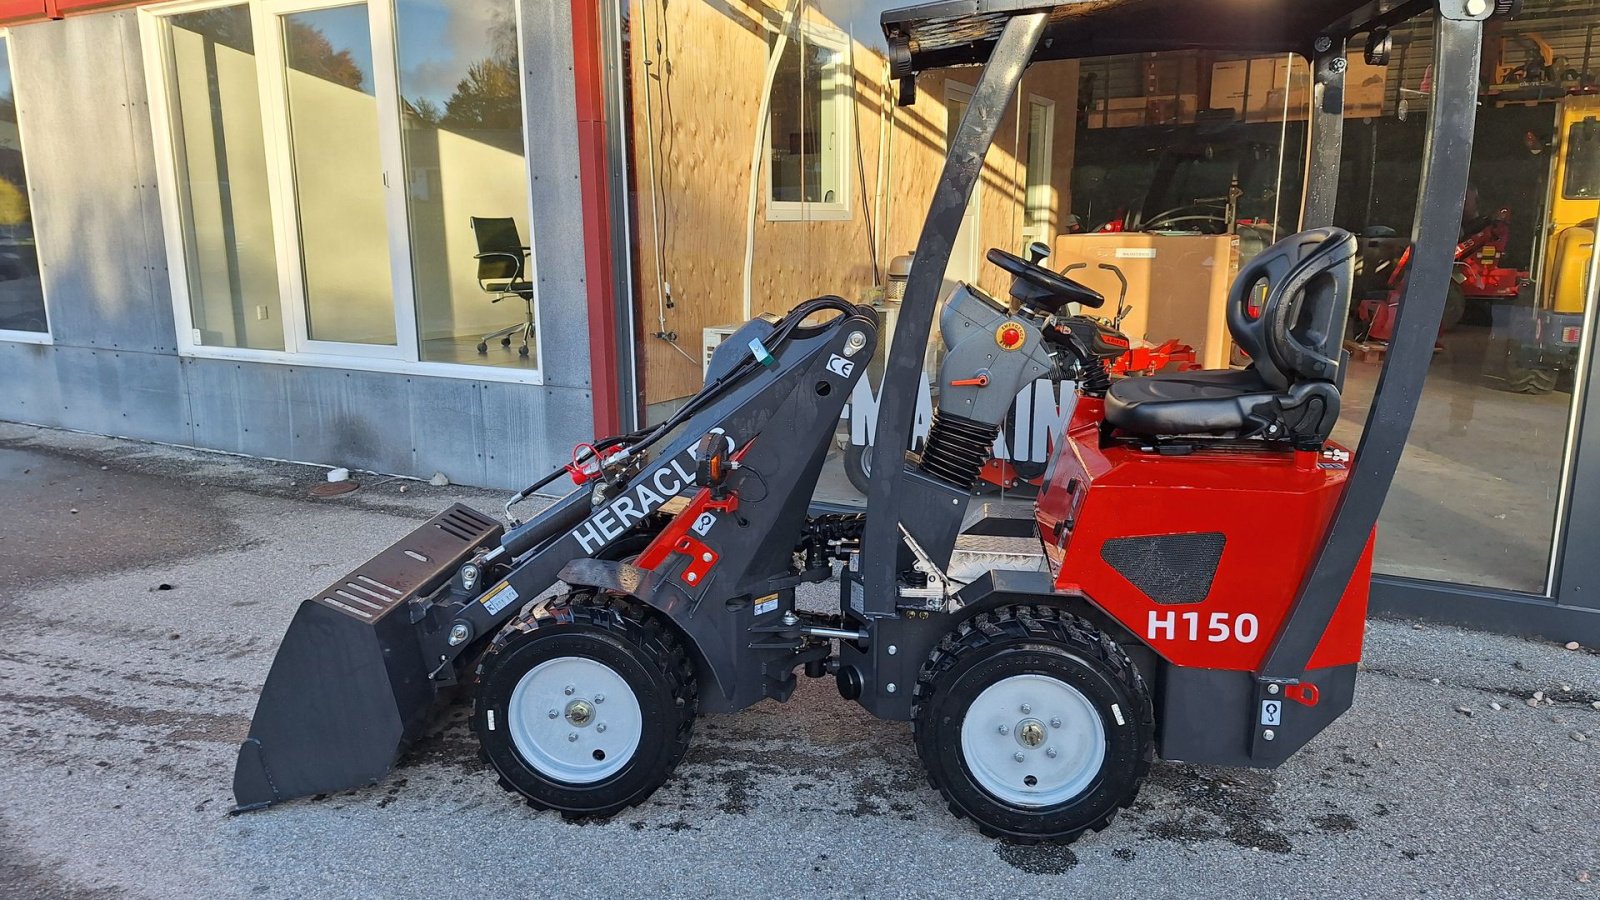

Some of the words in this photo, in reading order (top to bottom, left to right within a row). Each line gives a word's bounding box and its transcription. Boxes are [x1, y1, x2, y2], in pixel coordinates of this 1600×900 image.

[1001, 323, 1023, 339] EMERGENCY
[830, 357, 853, 377] CE
[1147, 610, 1259, 644] H150
